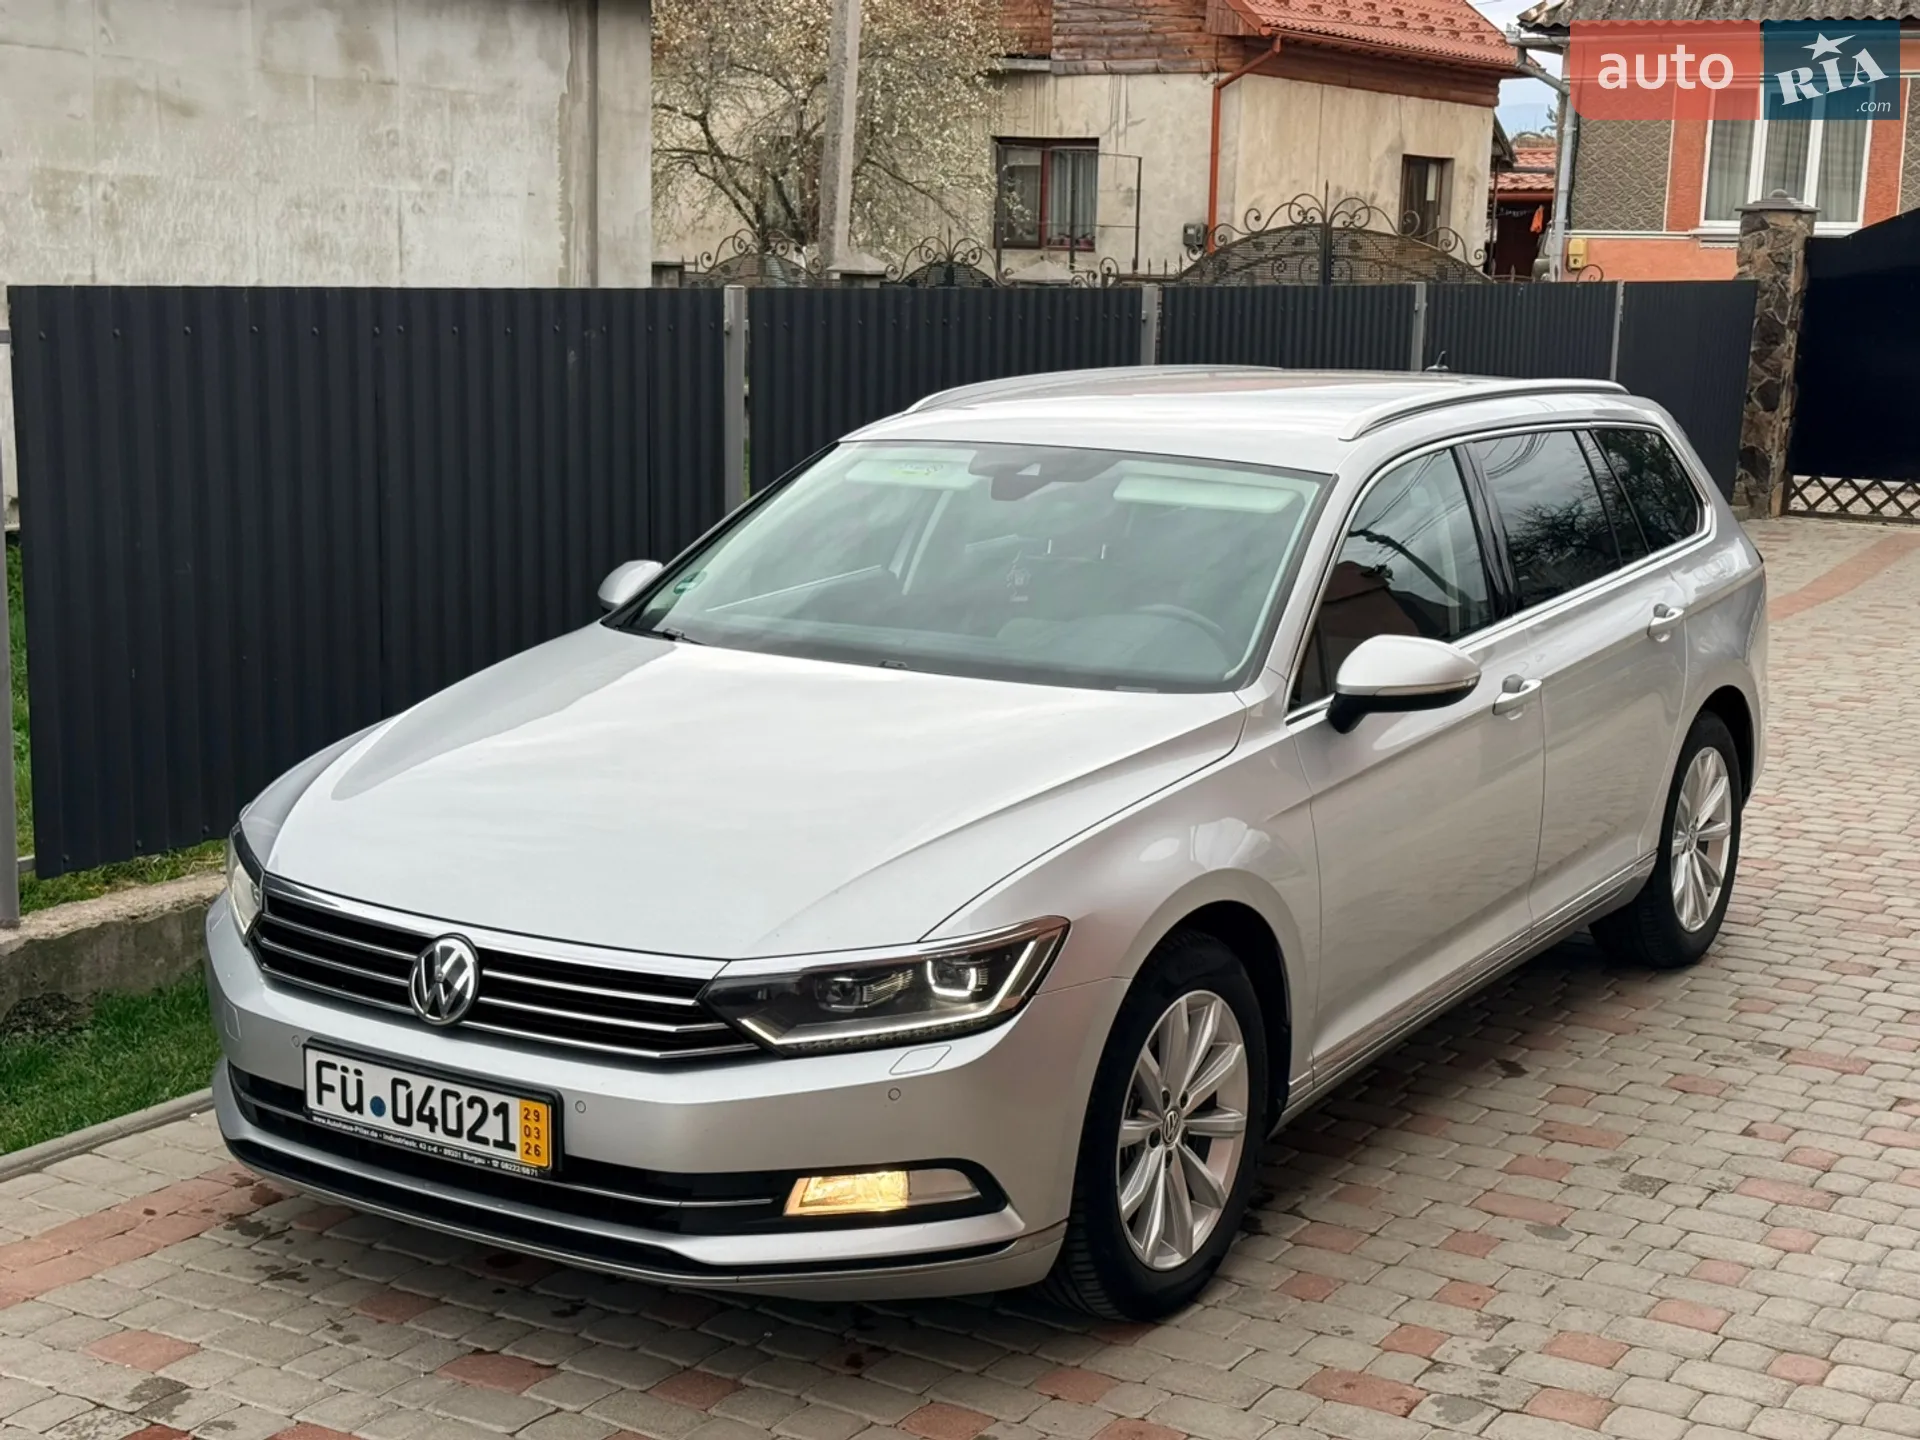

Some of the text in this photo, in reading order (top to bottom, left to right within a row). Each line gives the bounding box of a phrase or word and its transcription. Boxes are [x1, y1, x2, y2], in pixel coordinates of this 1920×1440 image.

[315, 1059, 516, 1153] FÜ 04021
[523, 1107, 541, 1123] 29
[524, 1123, 541, 1140] 03
[524, 1141, 541, 1157] 26
